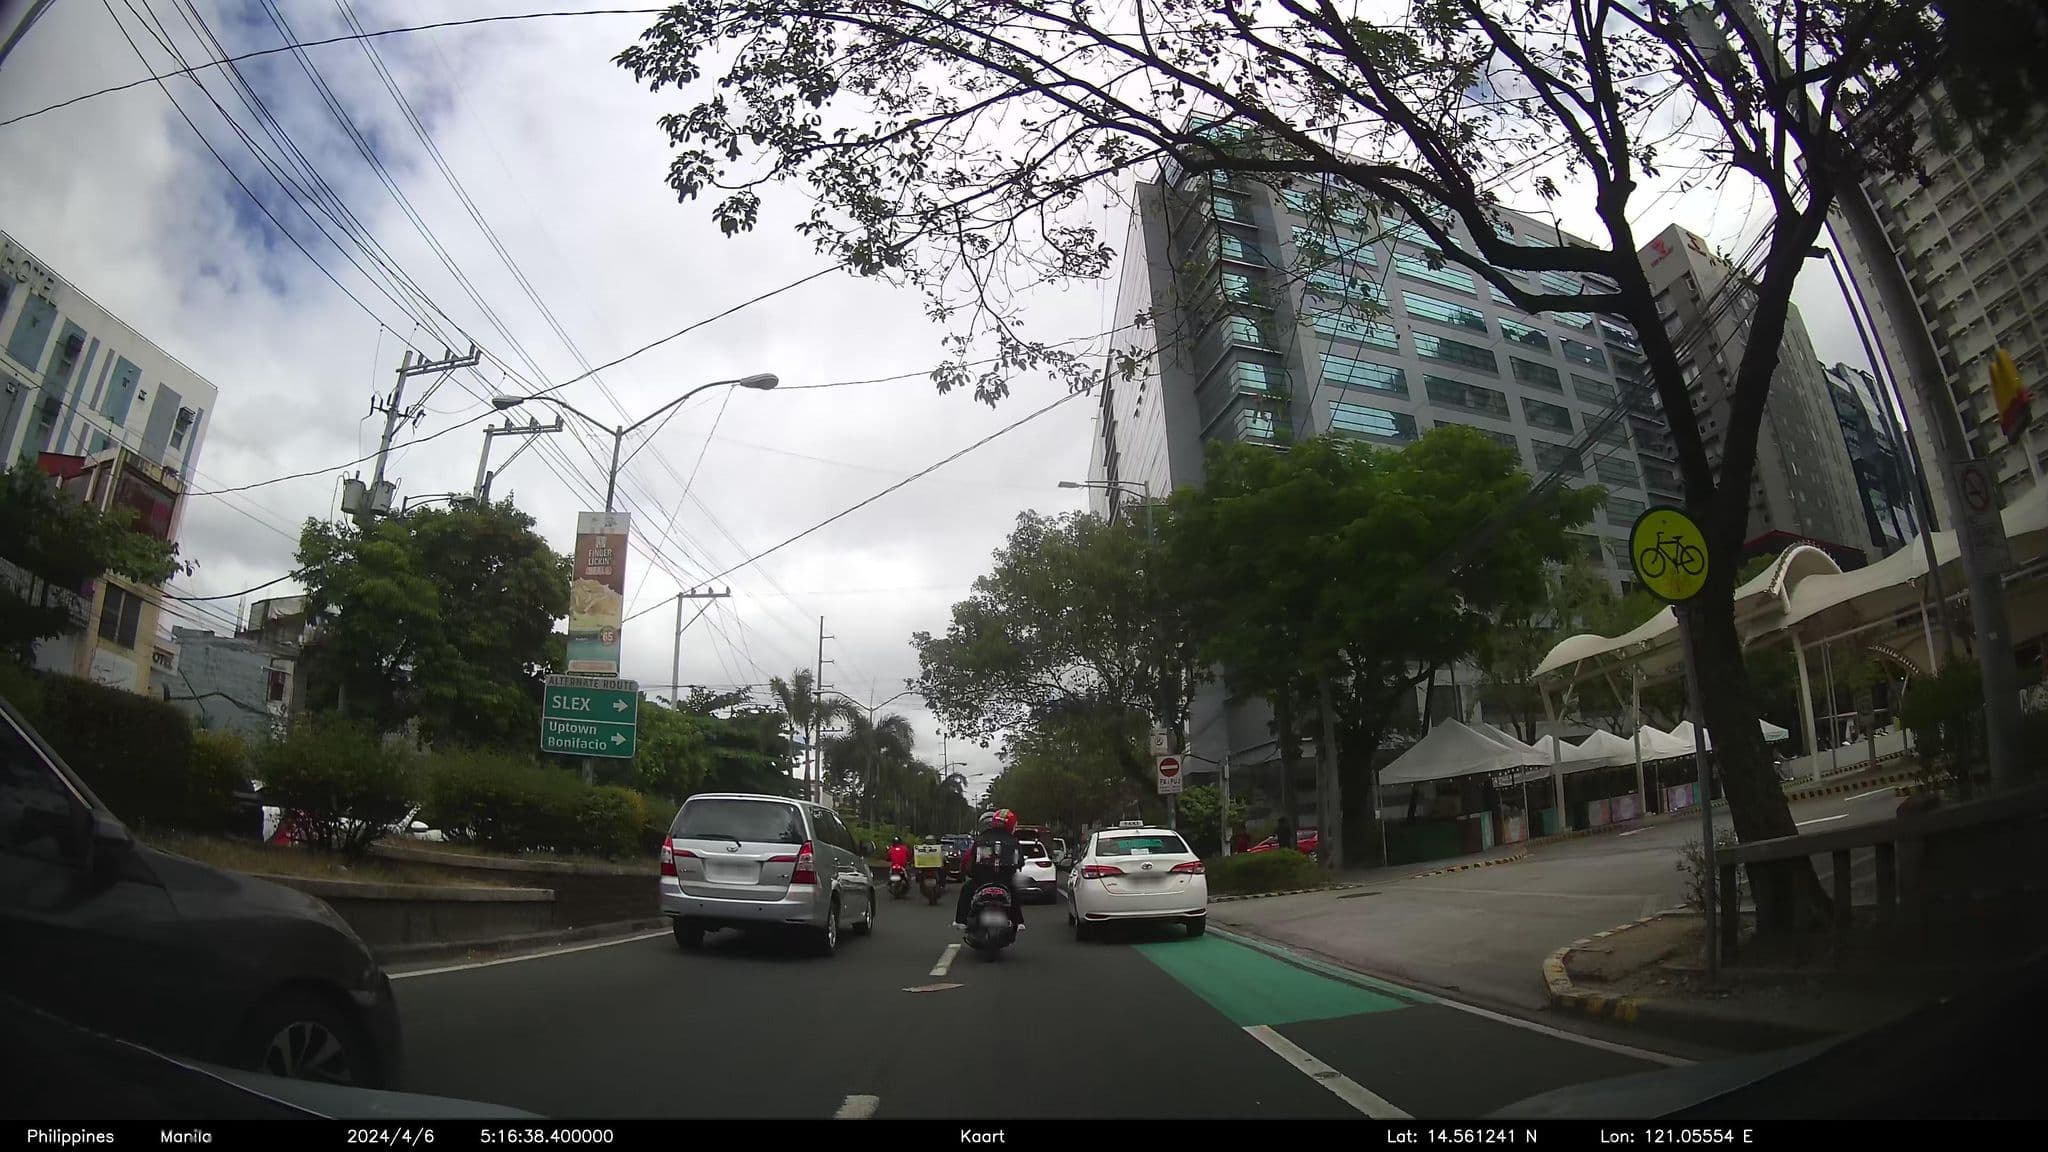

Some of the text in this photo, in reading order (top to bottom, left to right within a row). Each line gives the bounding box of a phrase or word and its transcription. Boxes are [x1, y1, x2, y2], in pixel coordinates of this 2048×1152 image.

[548, 677, 634, 690] ALTERNATE ROUTE
[551, 695, 591, 711] SLEX
[549, 721, 597, 735] Uptown
[548, 736, 607, 751] Bonifacio
